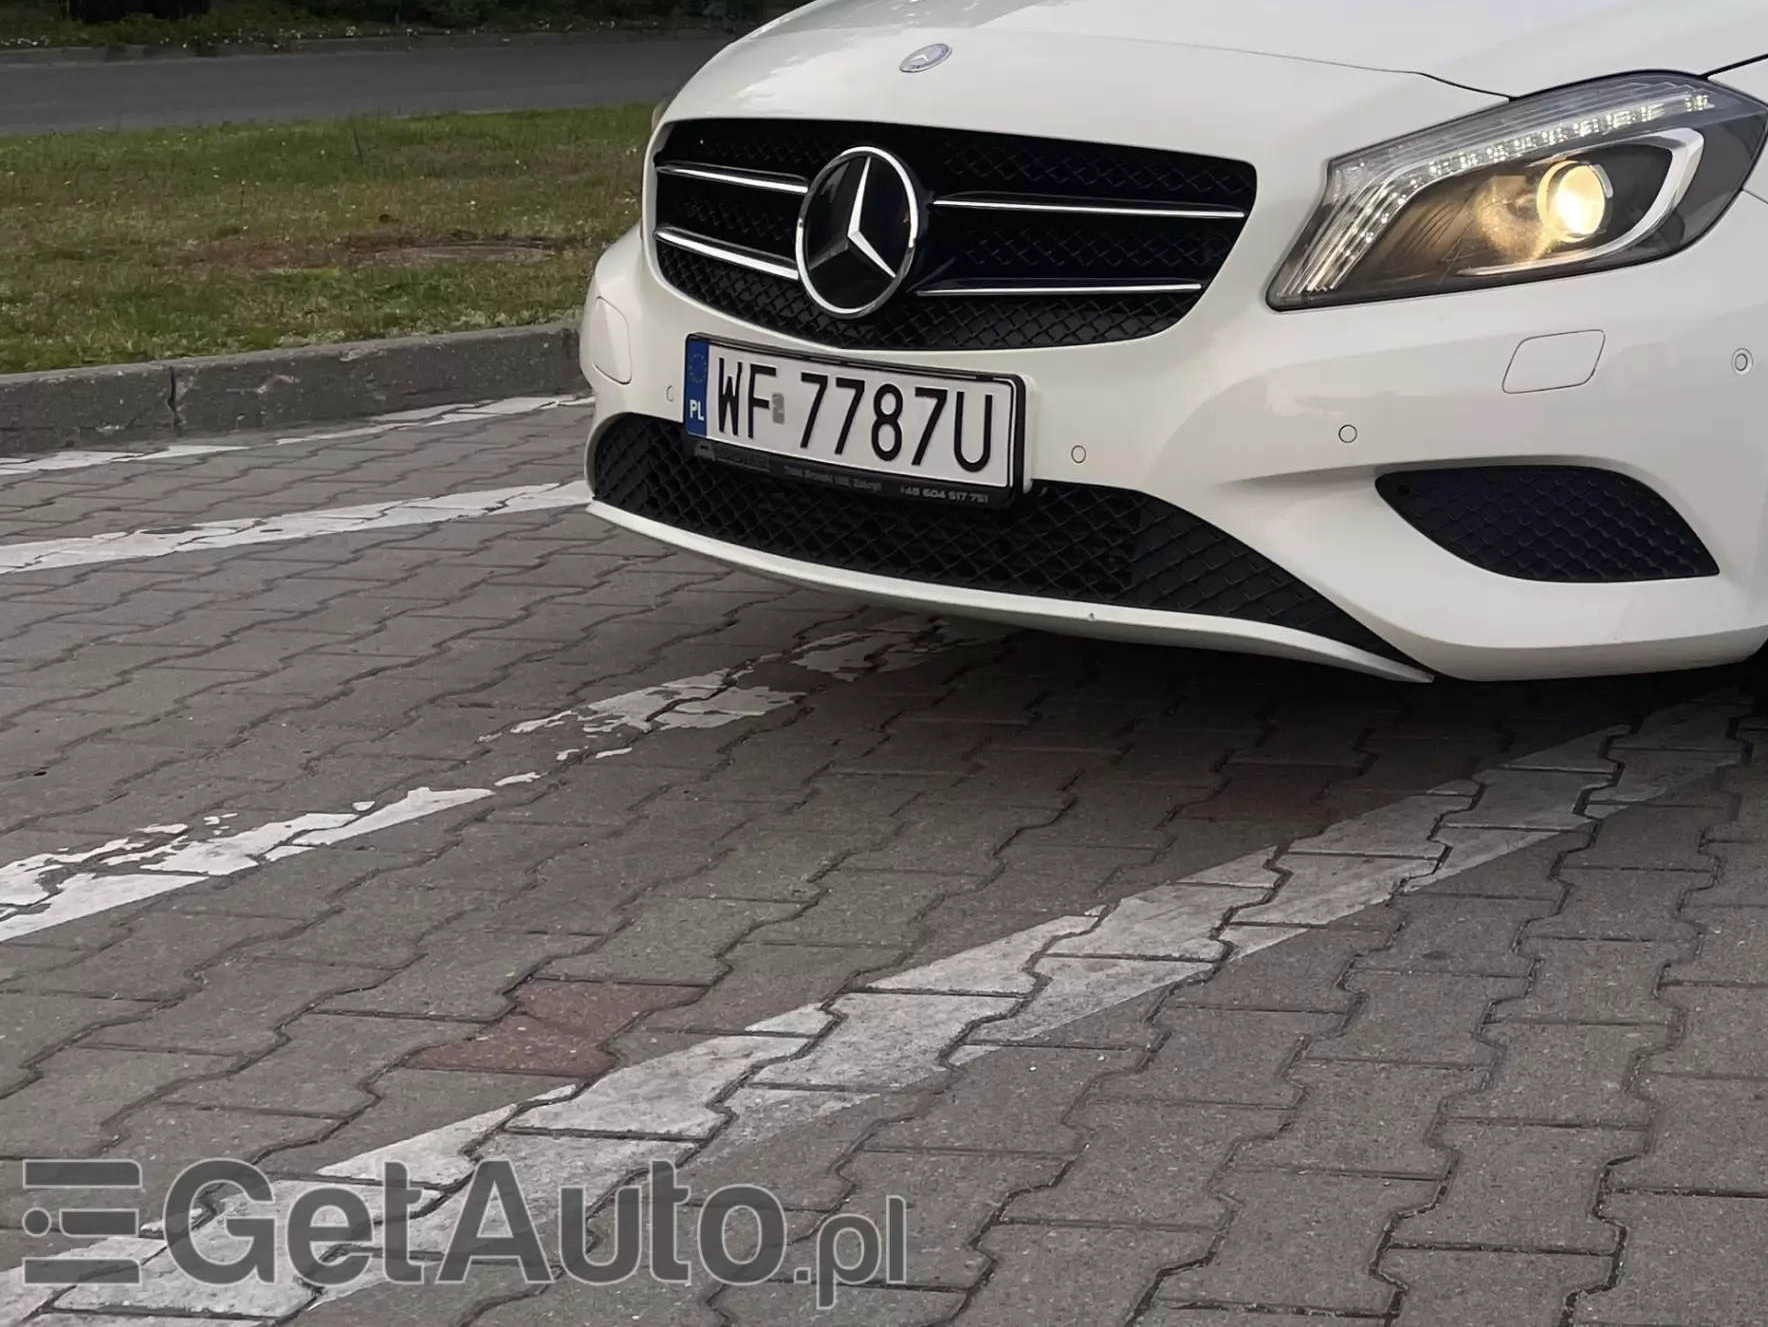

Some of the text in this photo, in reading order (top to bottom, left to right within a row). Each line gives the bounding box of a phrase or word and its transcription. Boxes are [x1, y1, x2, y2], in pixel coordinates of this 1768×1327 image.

[689, 399, 705, 421] PL
[718, 357, 994, 473] WF 7787U
